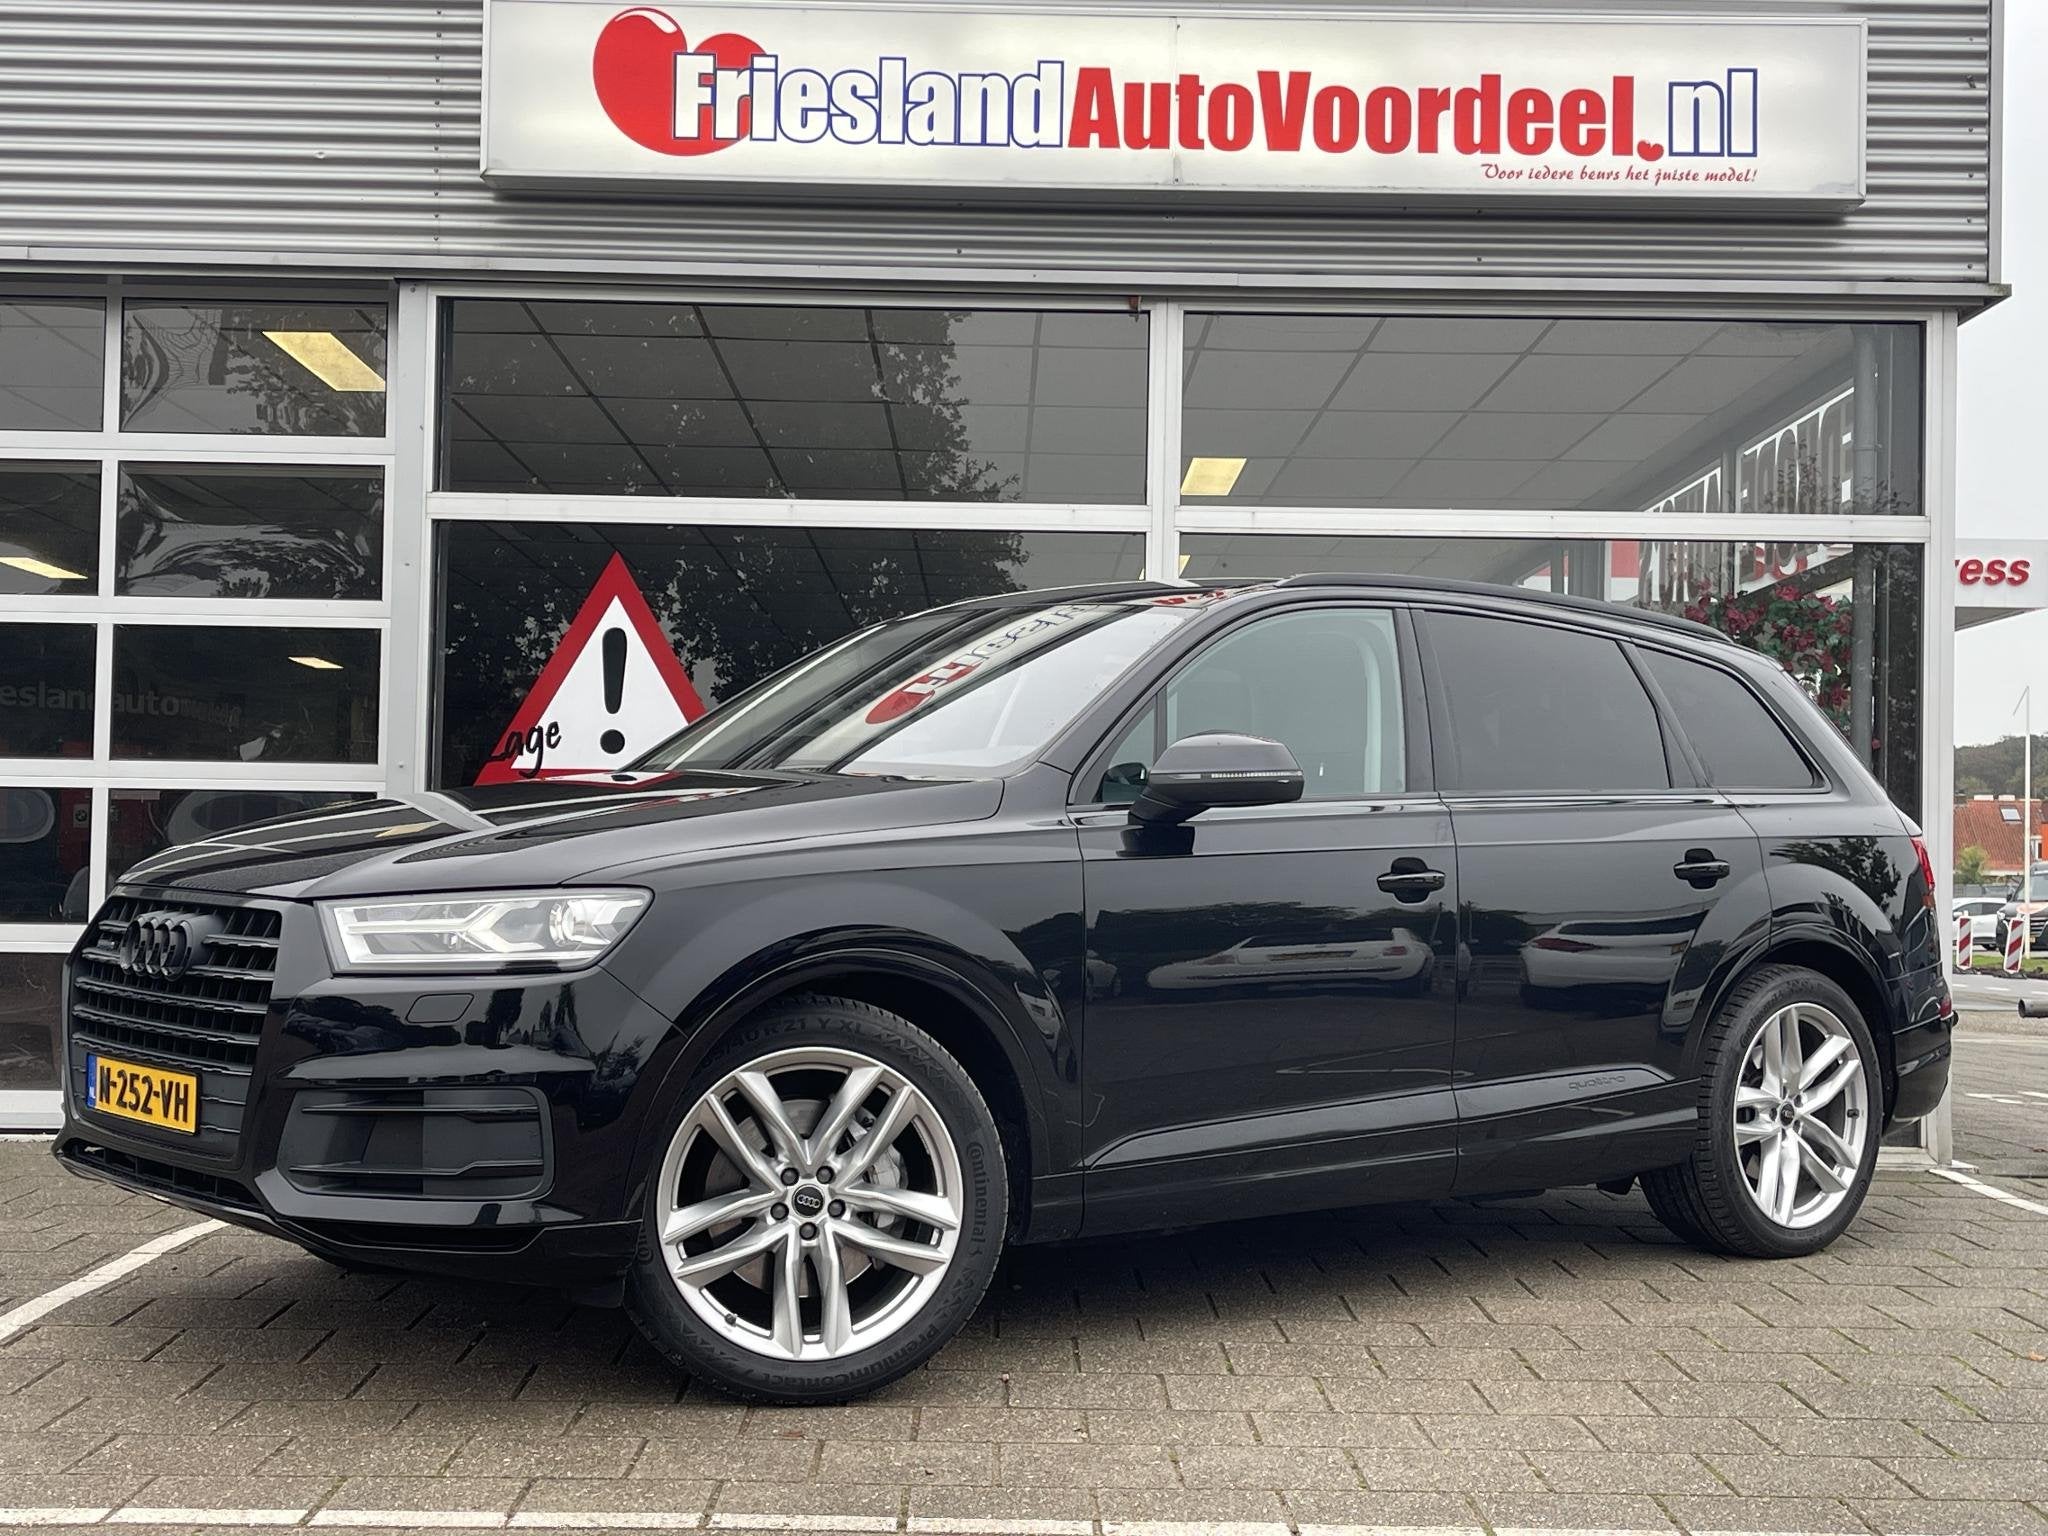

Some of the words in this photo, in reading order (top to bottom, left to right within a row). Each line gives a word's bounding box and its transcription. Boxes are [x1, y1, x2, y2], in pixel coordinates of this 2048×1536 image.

[1481, 163, 1522, 180] Voor
[1528, 165, 1574, 181] iedere
[1579, 165, 1621, 182] beurs
[1625, 165, 1650, 181] het
[1654, 168, 1700, 186] juiste
[1704, 167, 1759, 183] model!
[1955, 558, 2031, 587] ess
[99, 1065, 191, 1124] N-252-VH
[1568, 1075, 1626, 1092] quattro
